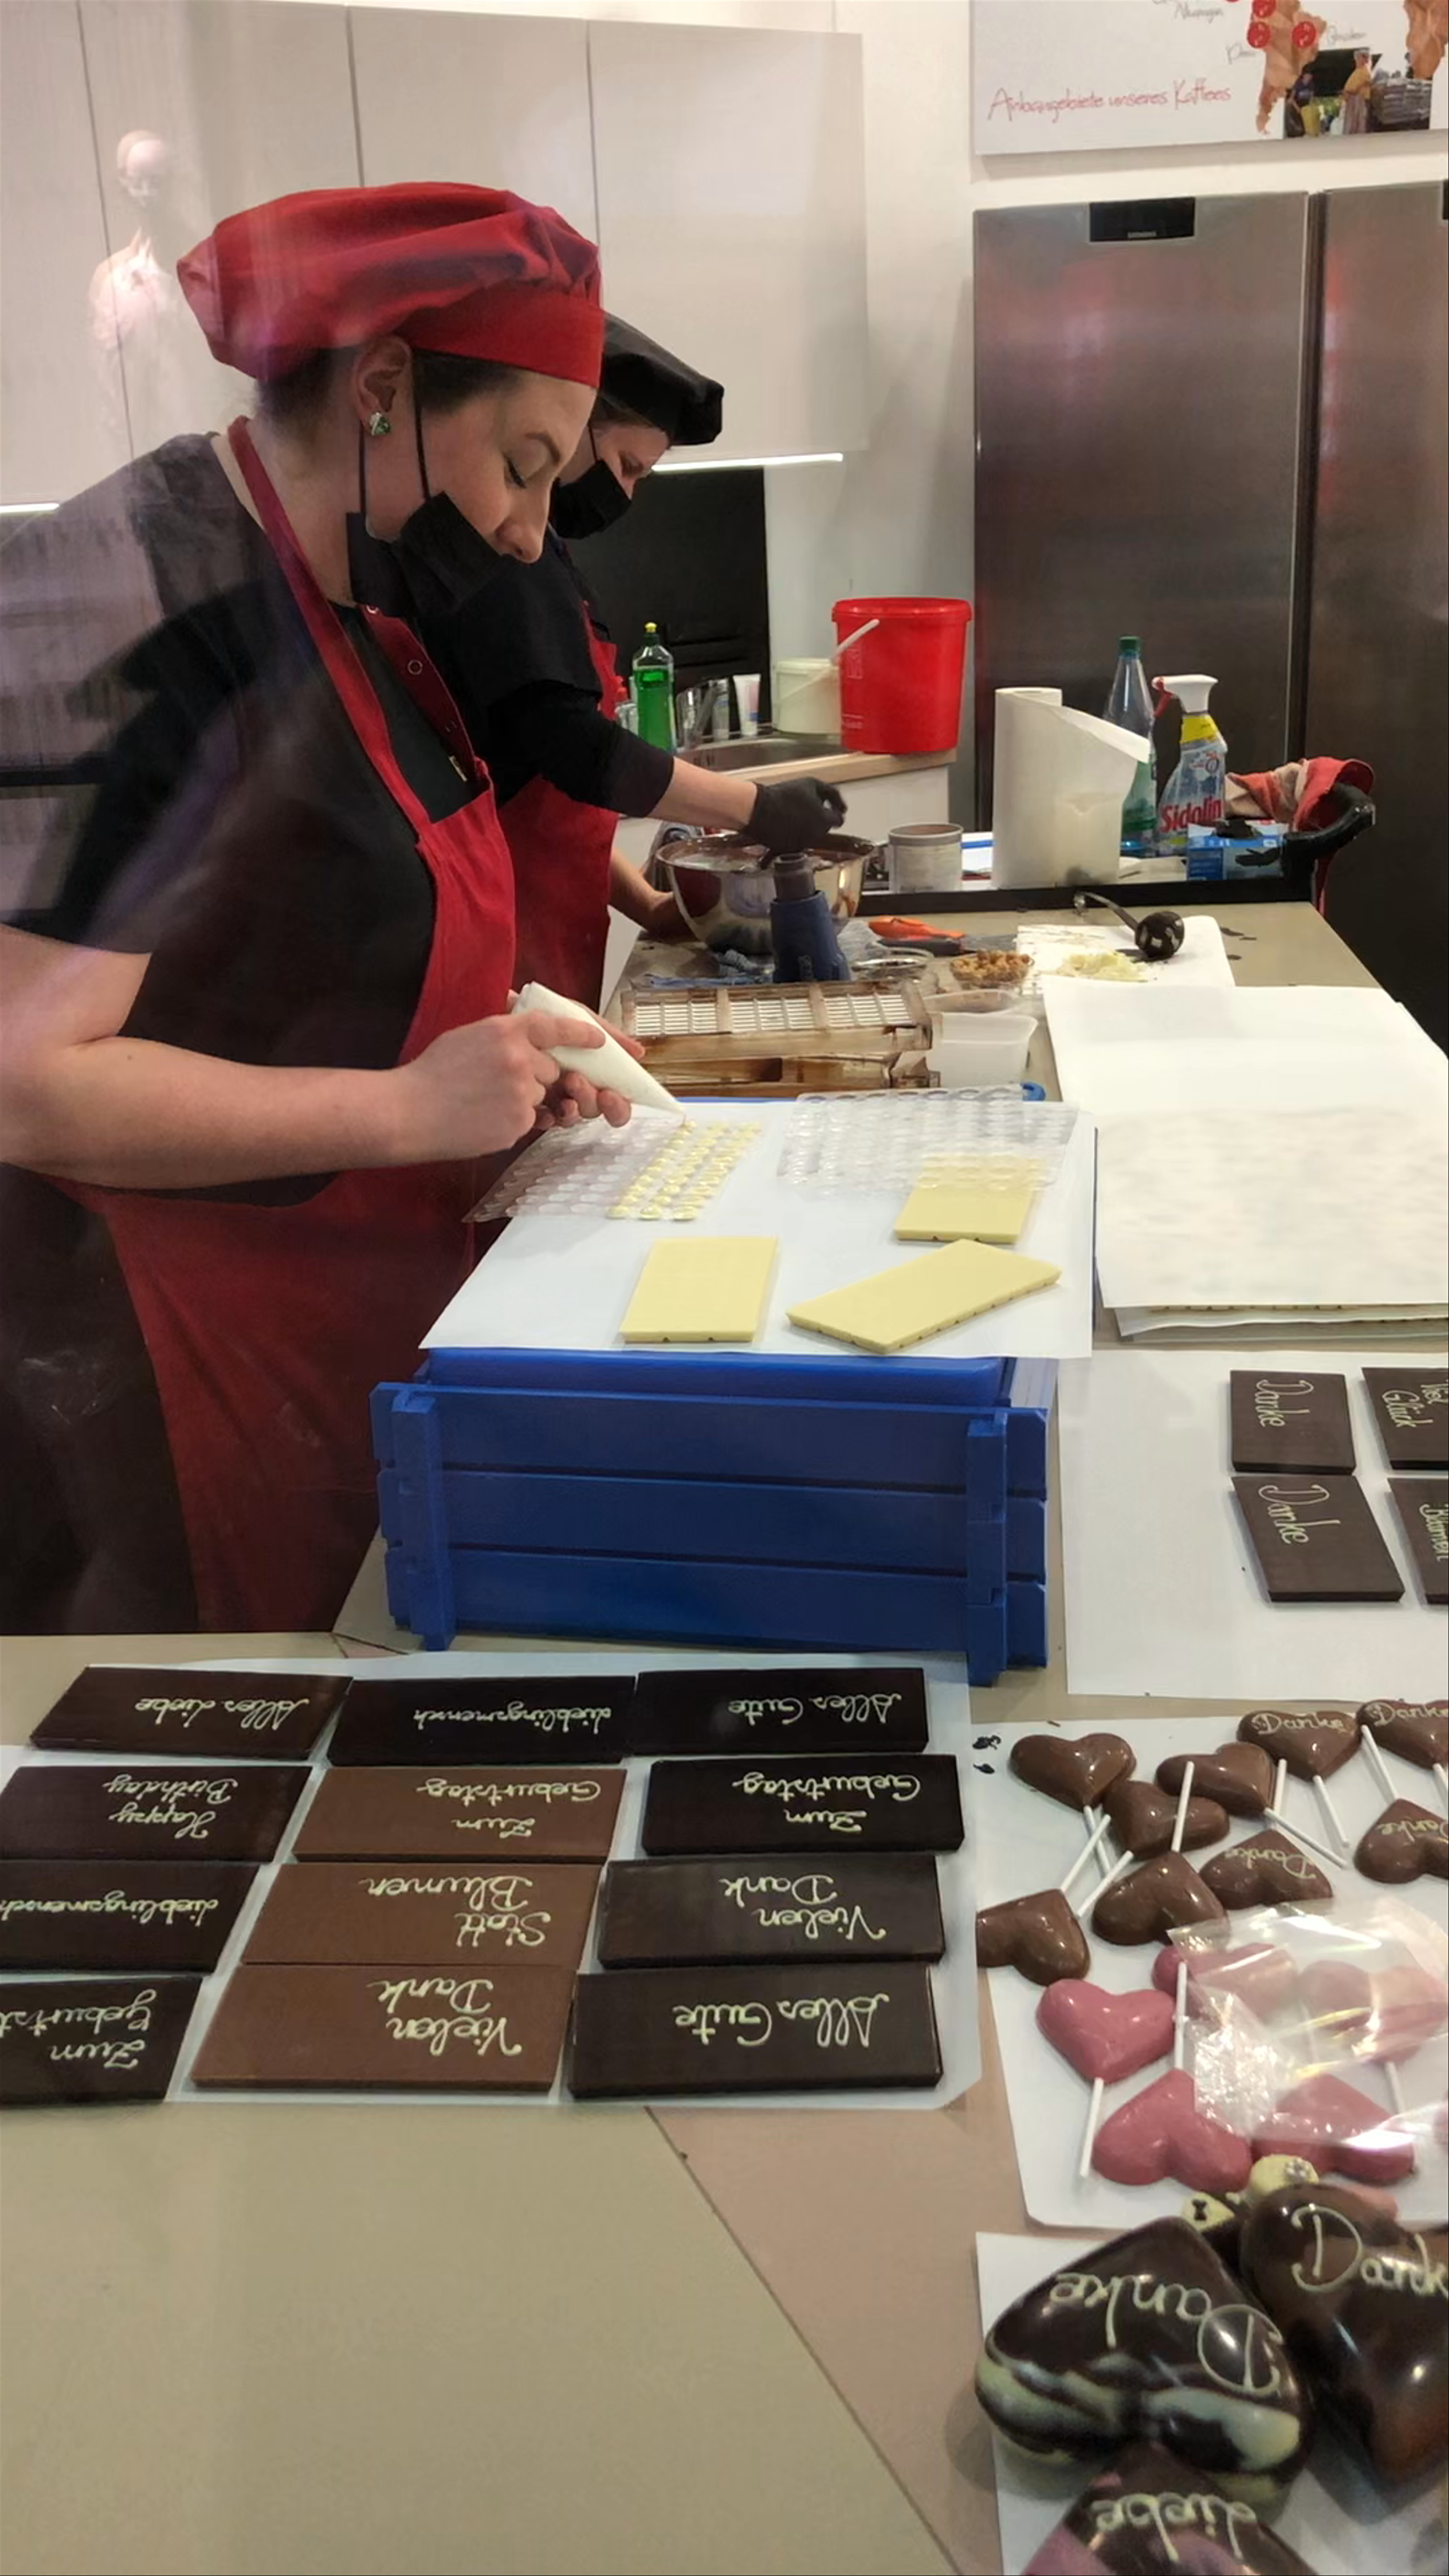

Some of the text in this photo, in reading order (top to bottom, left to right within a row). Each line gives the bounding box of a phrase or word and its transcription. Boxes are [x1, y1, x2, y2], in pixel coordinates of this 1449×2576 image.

[1160, 796, 1223, 833] Sidolin
[1255, 1380, 1314, 1427] Danke
[1382, 1390, 1433, 1427] Glück
[1258, 1484, 1341, 1544] Danke
[135, 1697, 309, 1730] Alles Liebe
[414, 1701, 611, 1733] Lieblingsmensch
[729, 1693, 901, 1725] Alles Gute
[1252, 1712, 1346, 1735] Danke
[103, 1774, 238, 1804] Birthday
[417, 1779, 601, 1807] Geburtstag
[733, 1773, 921, 1801] Geburtstag
[109, 1801, 215, 1839] Happy
[454, 1817, 535, 1838] Zum
[784, 1809, 868, 1833] Zum
[1225, 1848, 1317, 1879] Danke
[360, 1876, 533, 1910] Blumen
[720, 1875, 837, 1906] Dank
[455, 1912, 551, 1947] Statt
[754, 1905, 886, 1939] Vielen
[368, 1978, 494, 2013] Dank
[386, 2017, 522, 2056] Vielen
[673, 1993, 890, 2047] Alles Gute
[50, 2039, 145, 2068] Zum
[1049, 2272, 1283, 2394] Danke
[1091, 2492, 1257, 2562] Liebe
